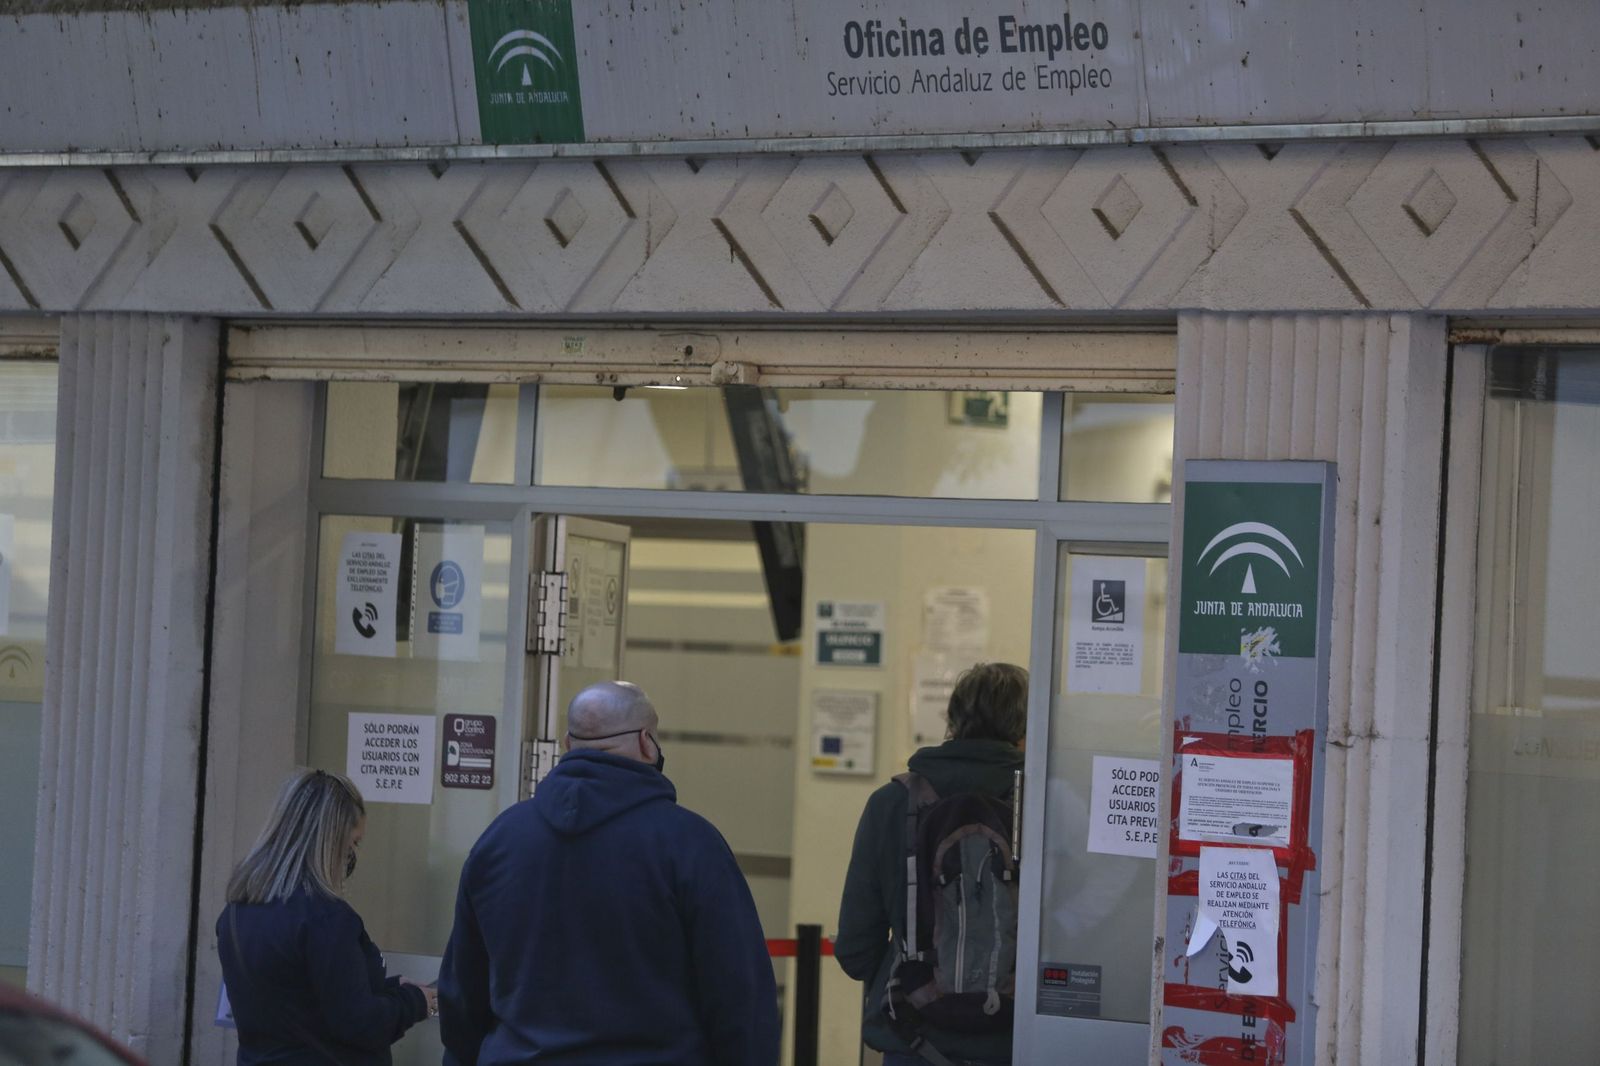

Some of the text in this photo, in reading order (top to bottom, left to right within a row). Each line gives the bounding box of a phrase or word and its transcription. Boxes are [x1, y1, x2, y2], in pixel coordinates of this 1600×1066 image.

[844, 13, 1109, 61] Oficina de Empleo
[827, 64, 1112, 96] Servicio Andaluz de Empleo
[490, 92, 513, 104] JUNTA
[515, 92, 525, 104] DE
[1194, 601, 1303, 618] JUNTA DE ANDALUCIA
[1225, 678, 1245, 750] mpleo
[1252, 680, 1268, 743] ERCIO
[364, 723, 419, 735] SÓLO PODRÁN
[365, 738, 418, 749] ACCEDER LOS
[362, 751, 419, 762] USUARIOS CON
[360, 764, 420, 776] CITA PREVIA EN
[1112, 767, 1160, 782] SÓLO POD
[444, 773, 492, 784] 902 26 22 22
[1112, 785, 1156, 797] ACCEDER
[1109, 799, 1155, 813] USUARIOS
[1107, 814, 1157, 828] CITA PREVI
[1217, 871, 1229, 879] LAS
[1230, 872, 1247, 880] CITAS
[1209, 881, 1267, 891] SERVICIO ANDALUZ
[1226, 891, 1251, 899] EMPLEO
[1252, 892, 1259, 900] SE
[1207, 900, 1269, 910] REALIZAN MEDIANTE
[1222, 910, 1253, 919] ATENCIÓN
[1219, 919, 1256, 928] TELEFÓNICA
